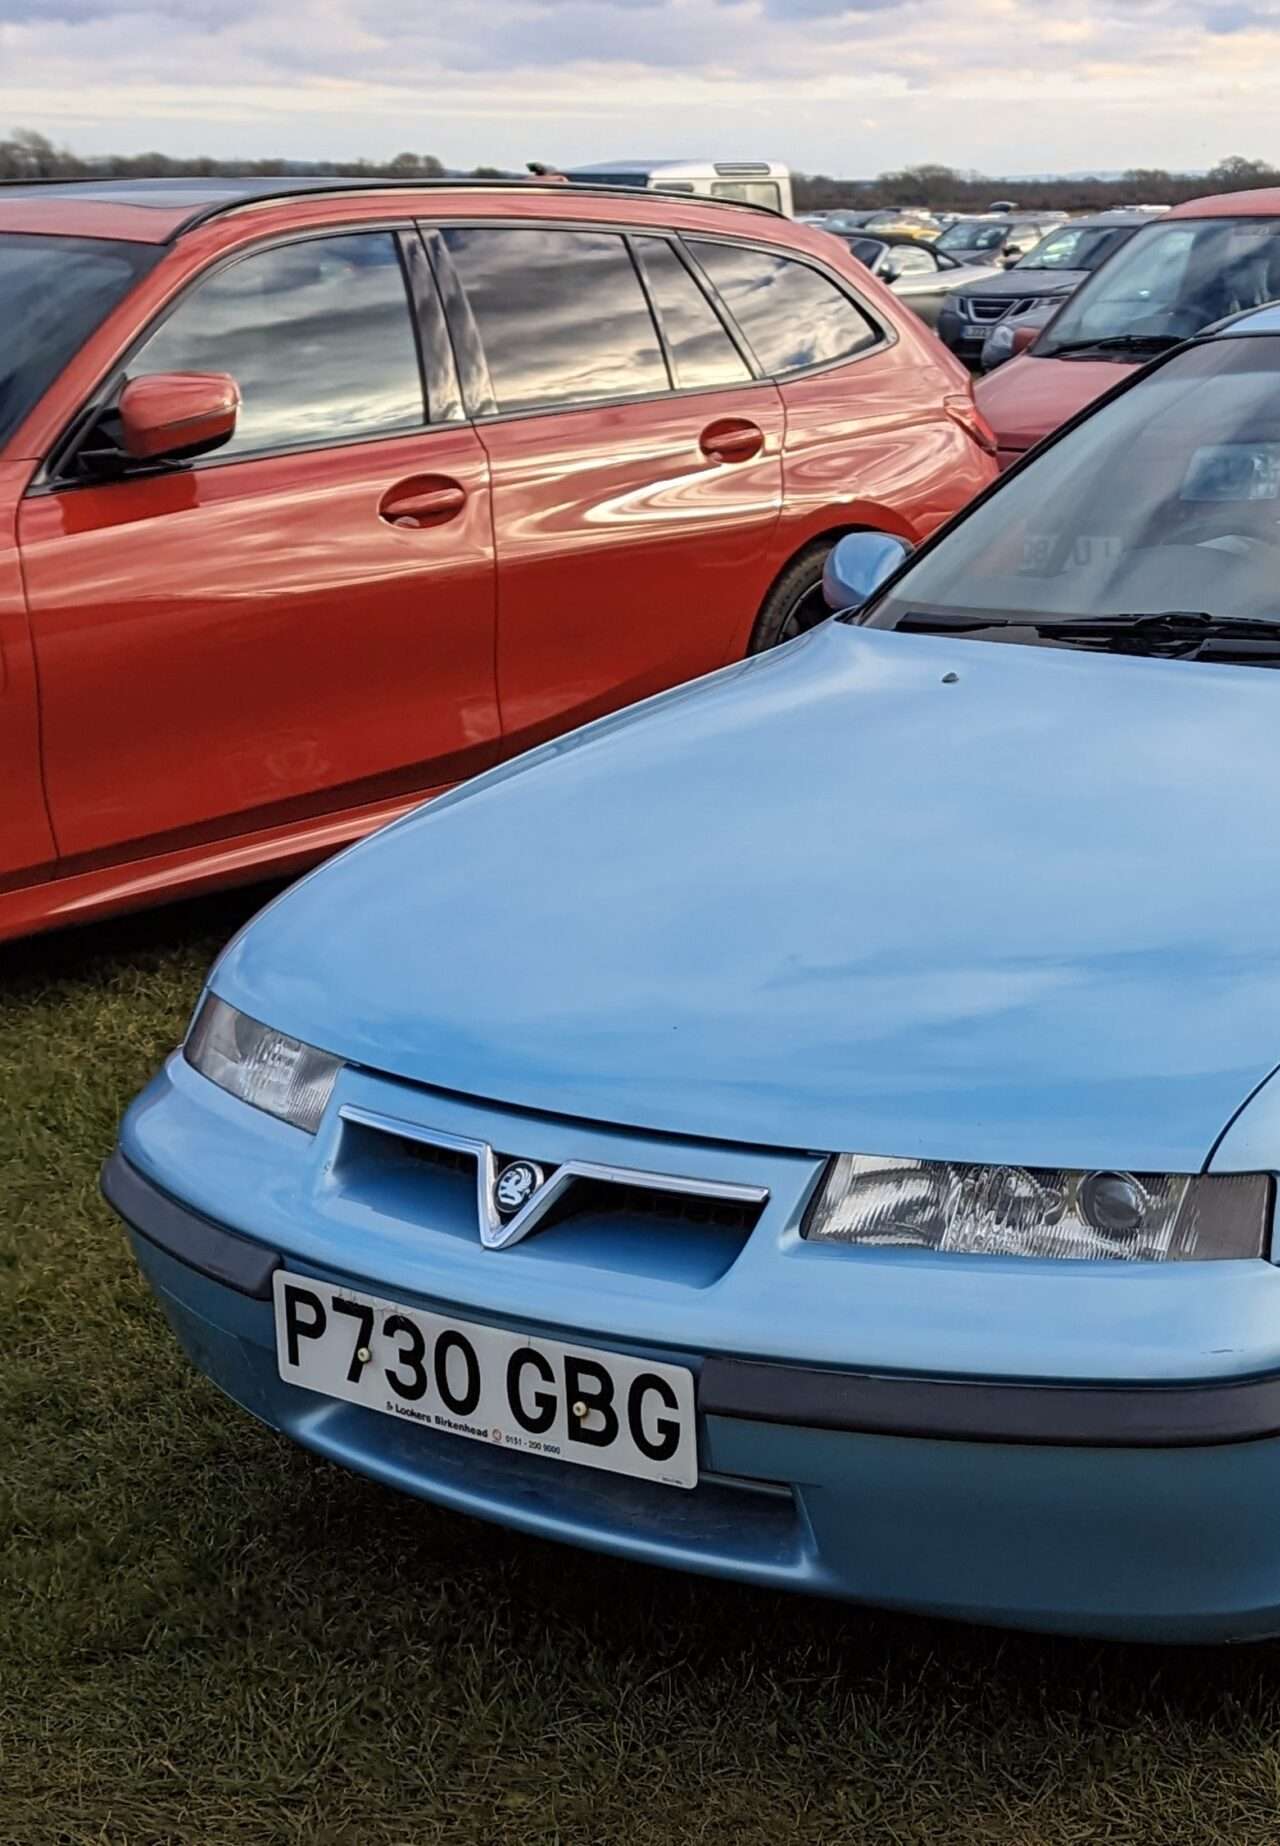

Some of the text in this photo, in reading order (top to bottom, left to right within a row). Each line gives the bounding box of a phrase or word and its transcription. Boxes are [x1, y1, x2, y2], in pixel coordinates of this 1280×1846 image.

[284, 1284, 681, 1462] P730 GBG
[434, 1415, 489, 1439] Birkenhead
